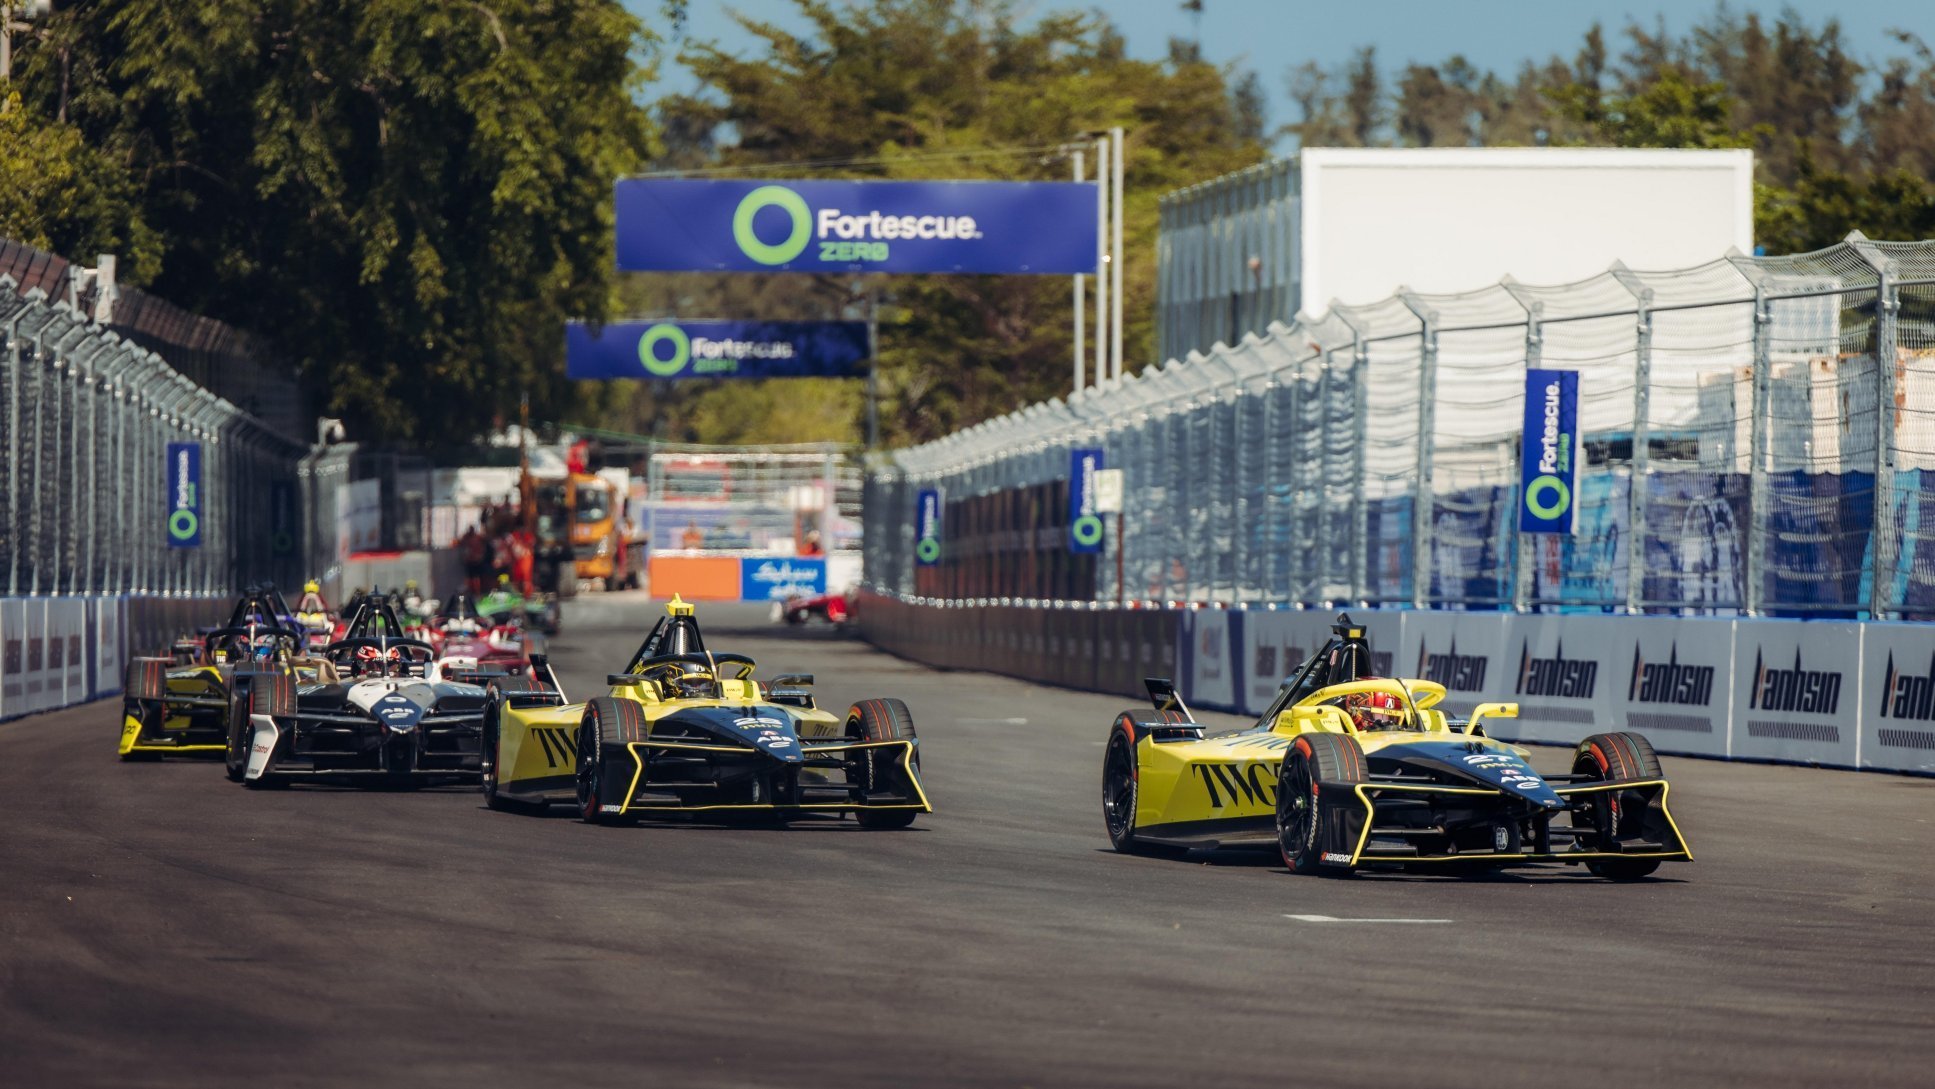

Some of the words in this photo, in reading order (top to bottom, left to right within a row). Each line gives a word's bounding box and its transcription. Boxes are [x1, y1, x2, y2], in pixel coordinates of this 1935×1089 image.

[818, 208, 977, 240] Fortescue
[818, 241, 889, 262] ZERO
[1539, 383, 1560, 474] Fortescue
